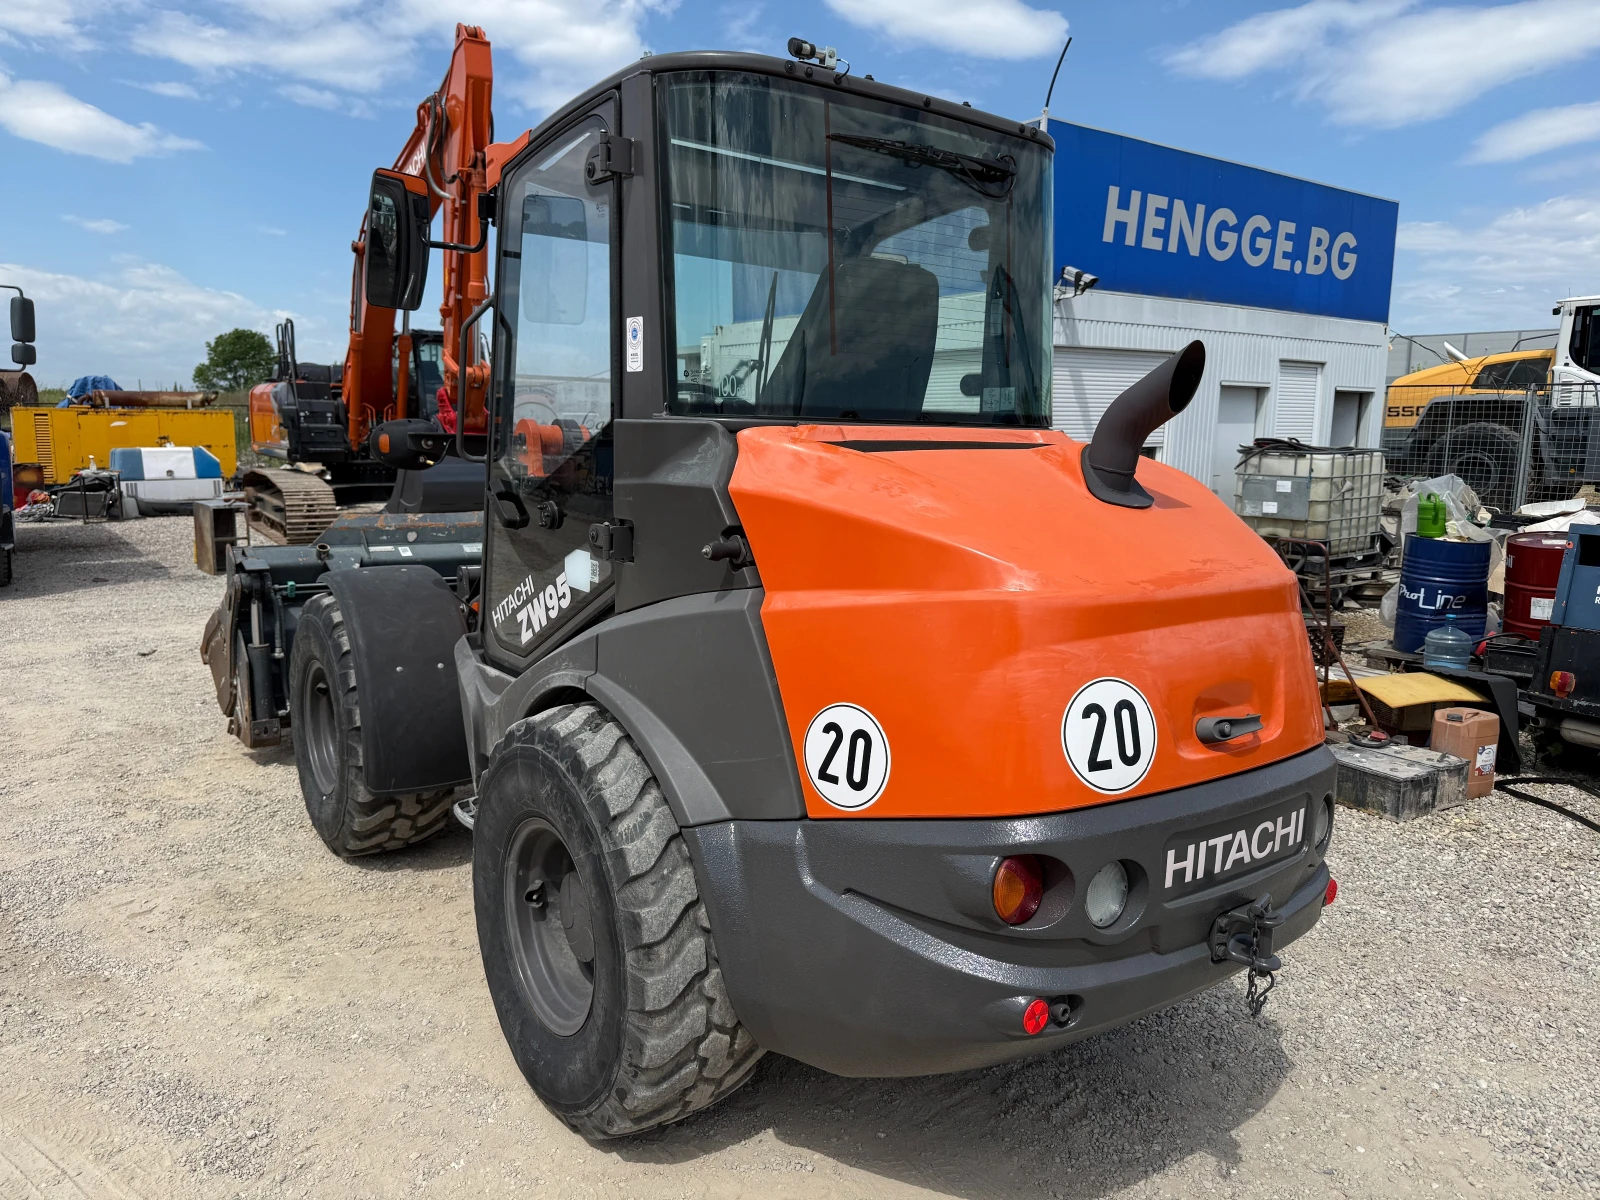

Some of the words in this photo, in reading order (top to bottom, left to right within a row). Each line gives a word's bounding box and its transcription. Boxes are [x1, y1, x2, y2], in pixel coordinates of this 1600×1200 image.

[1102, 185, 1358, 281] HENGGE.BG
[492, 575, 535, 628] HITACHI
[516, 572, 571, 645] ZW95
[818, 722, 872, 792] 20
[1082, 698, 1141, 773] 20
[1165, 808, 1305, 888] HITACHI
